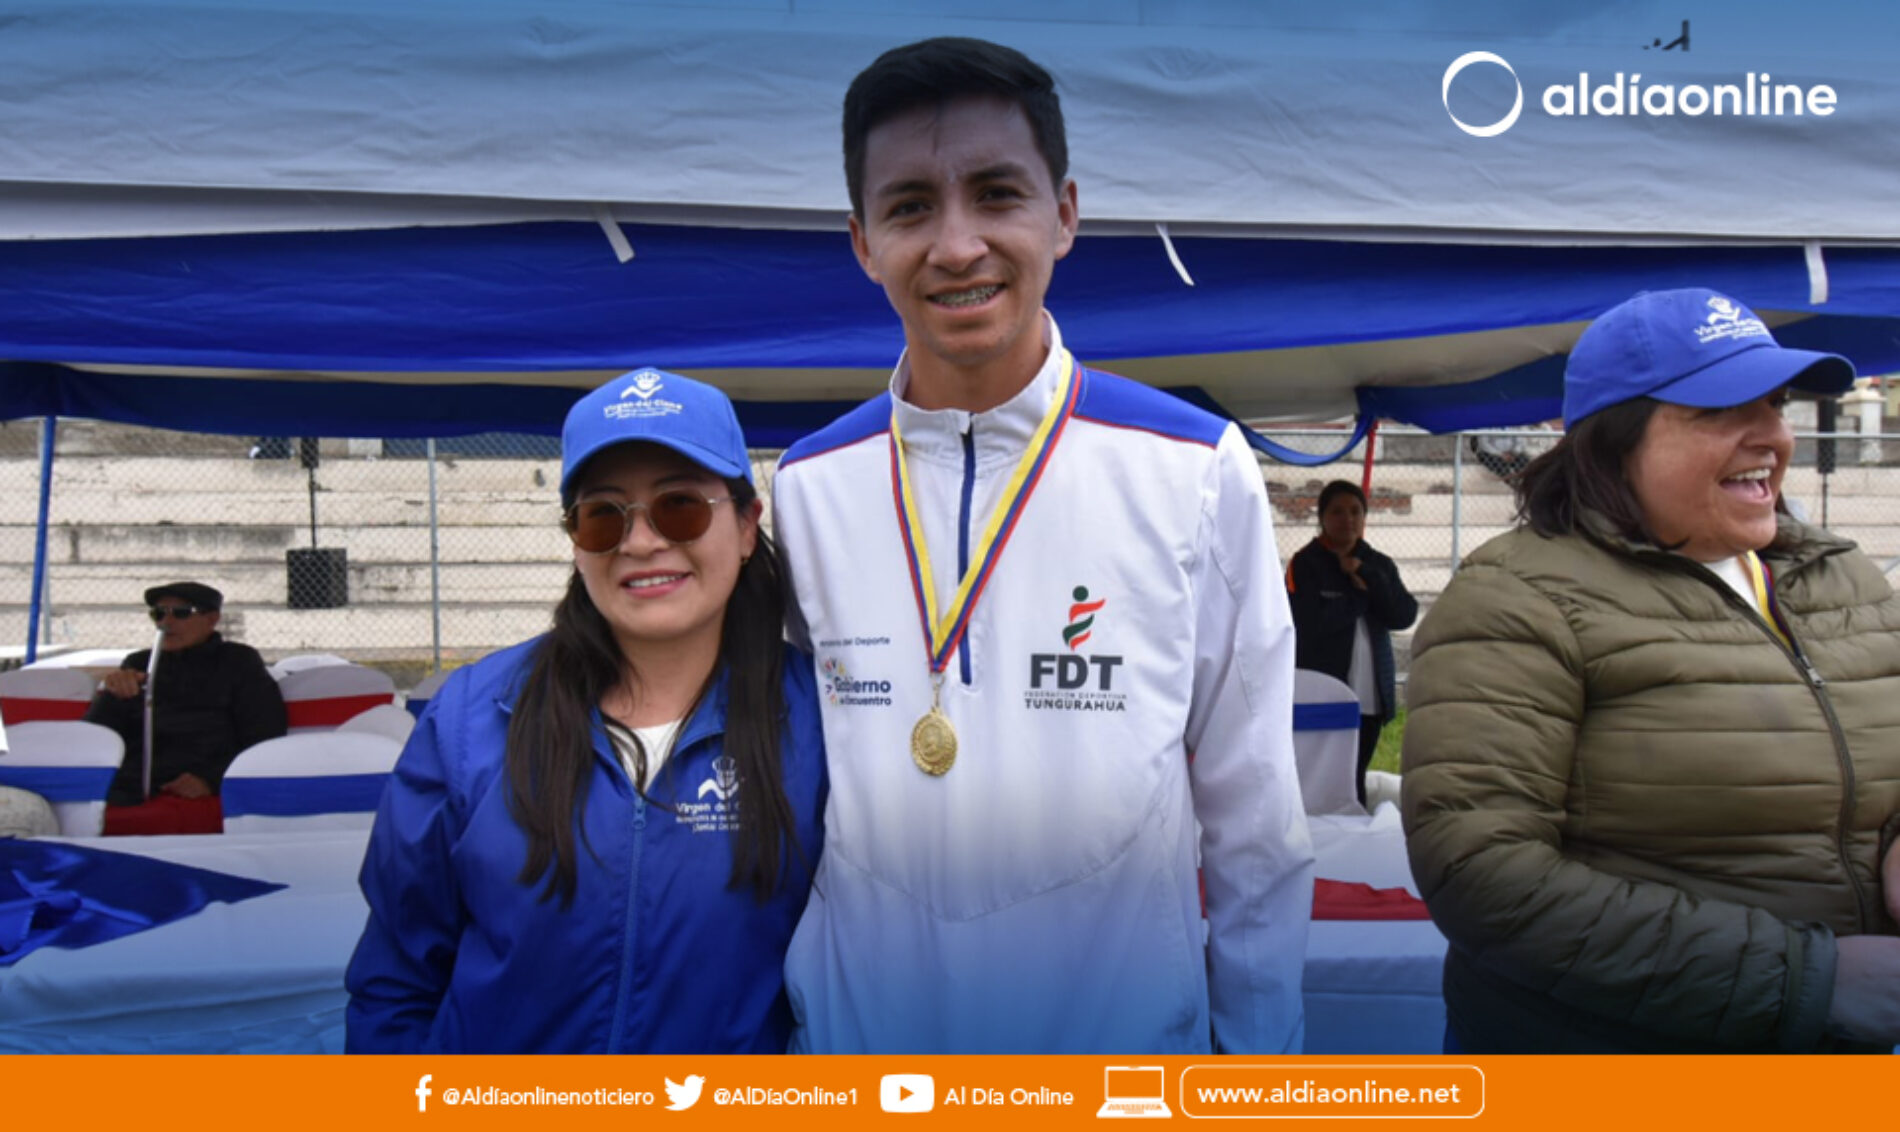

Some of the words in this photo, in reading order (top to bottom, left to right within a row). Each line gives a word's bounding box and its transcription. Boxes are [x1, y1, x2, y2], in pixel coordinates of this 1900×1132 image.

[854, 636, 890, 646] Deporte
[1030, 653, 1123, 691] FDT
[1024, 698, 1126, 712] TUNGURAHUA
[676, 802, 711, 816] Virgen
